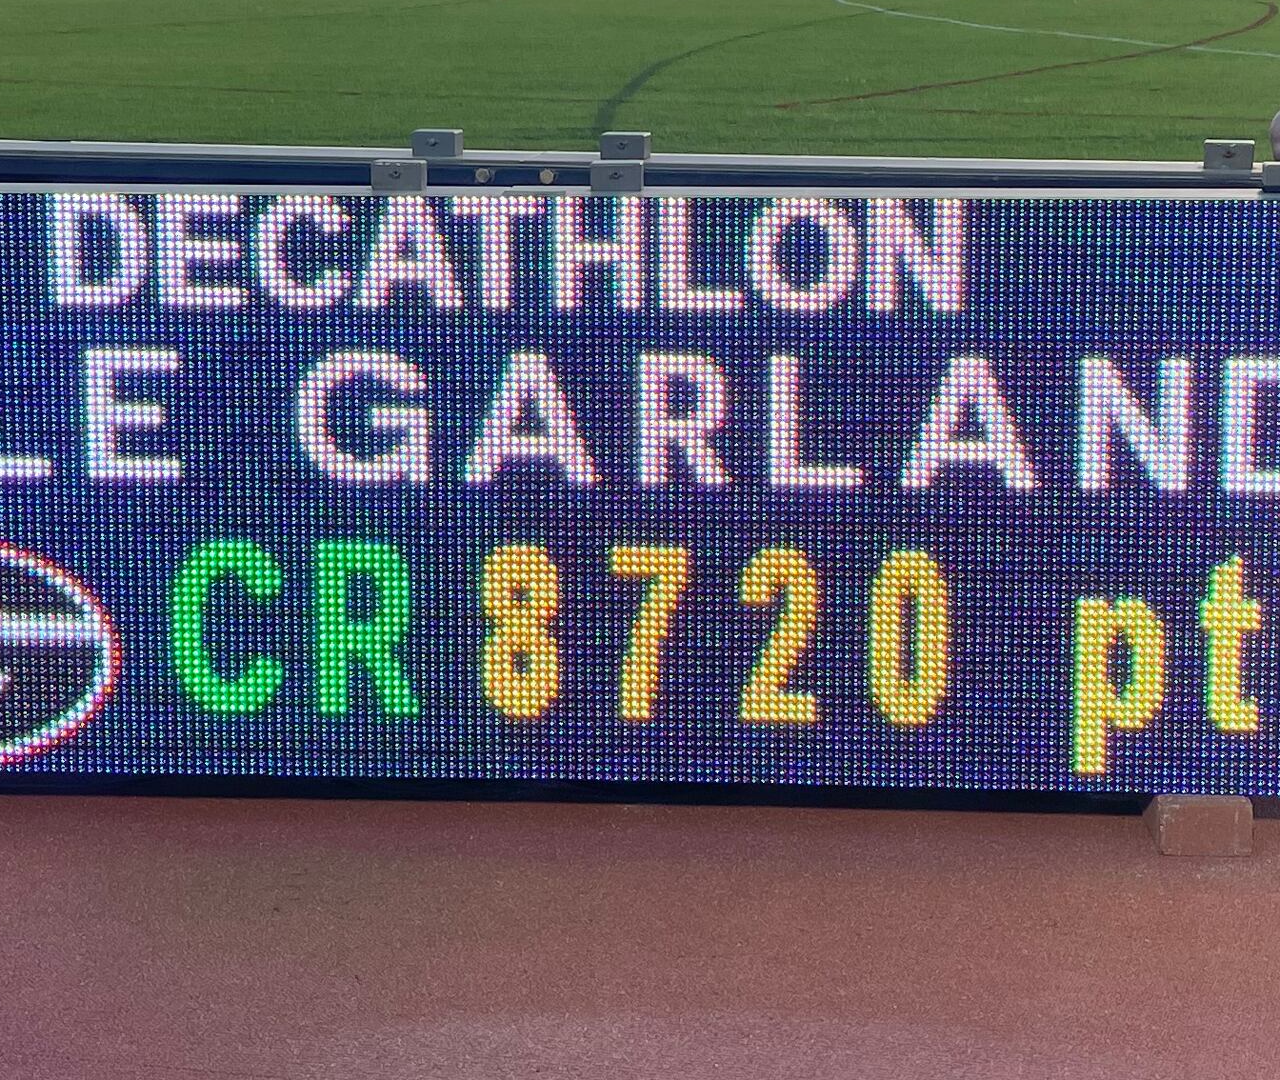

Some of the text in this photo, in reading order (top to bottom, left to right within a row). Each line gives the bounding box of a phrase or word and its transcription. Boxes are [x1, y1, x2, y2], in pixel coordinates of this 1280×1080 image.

[52, 192, 967, 314] DECATHLON
[171, 538, 421, 717] CR
[482, 542, 951, 726] 8720
